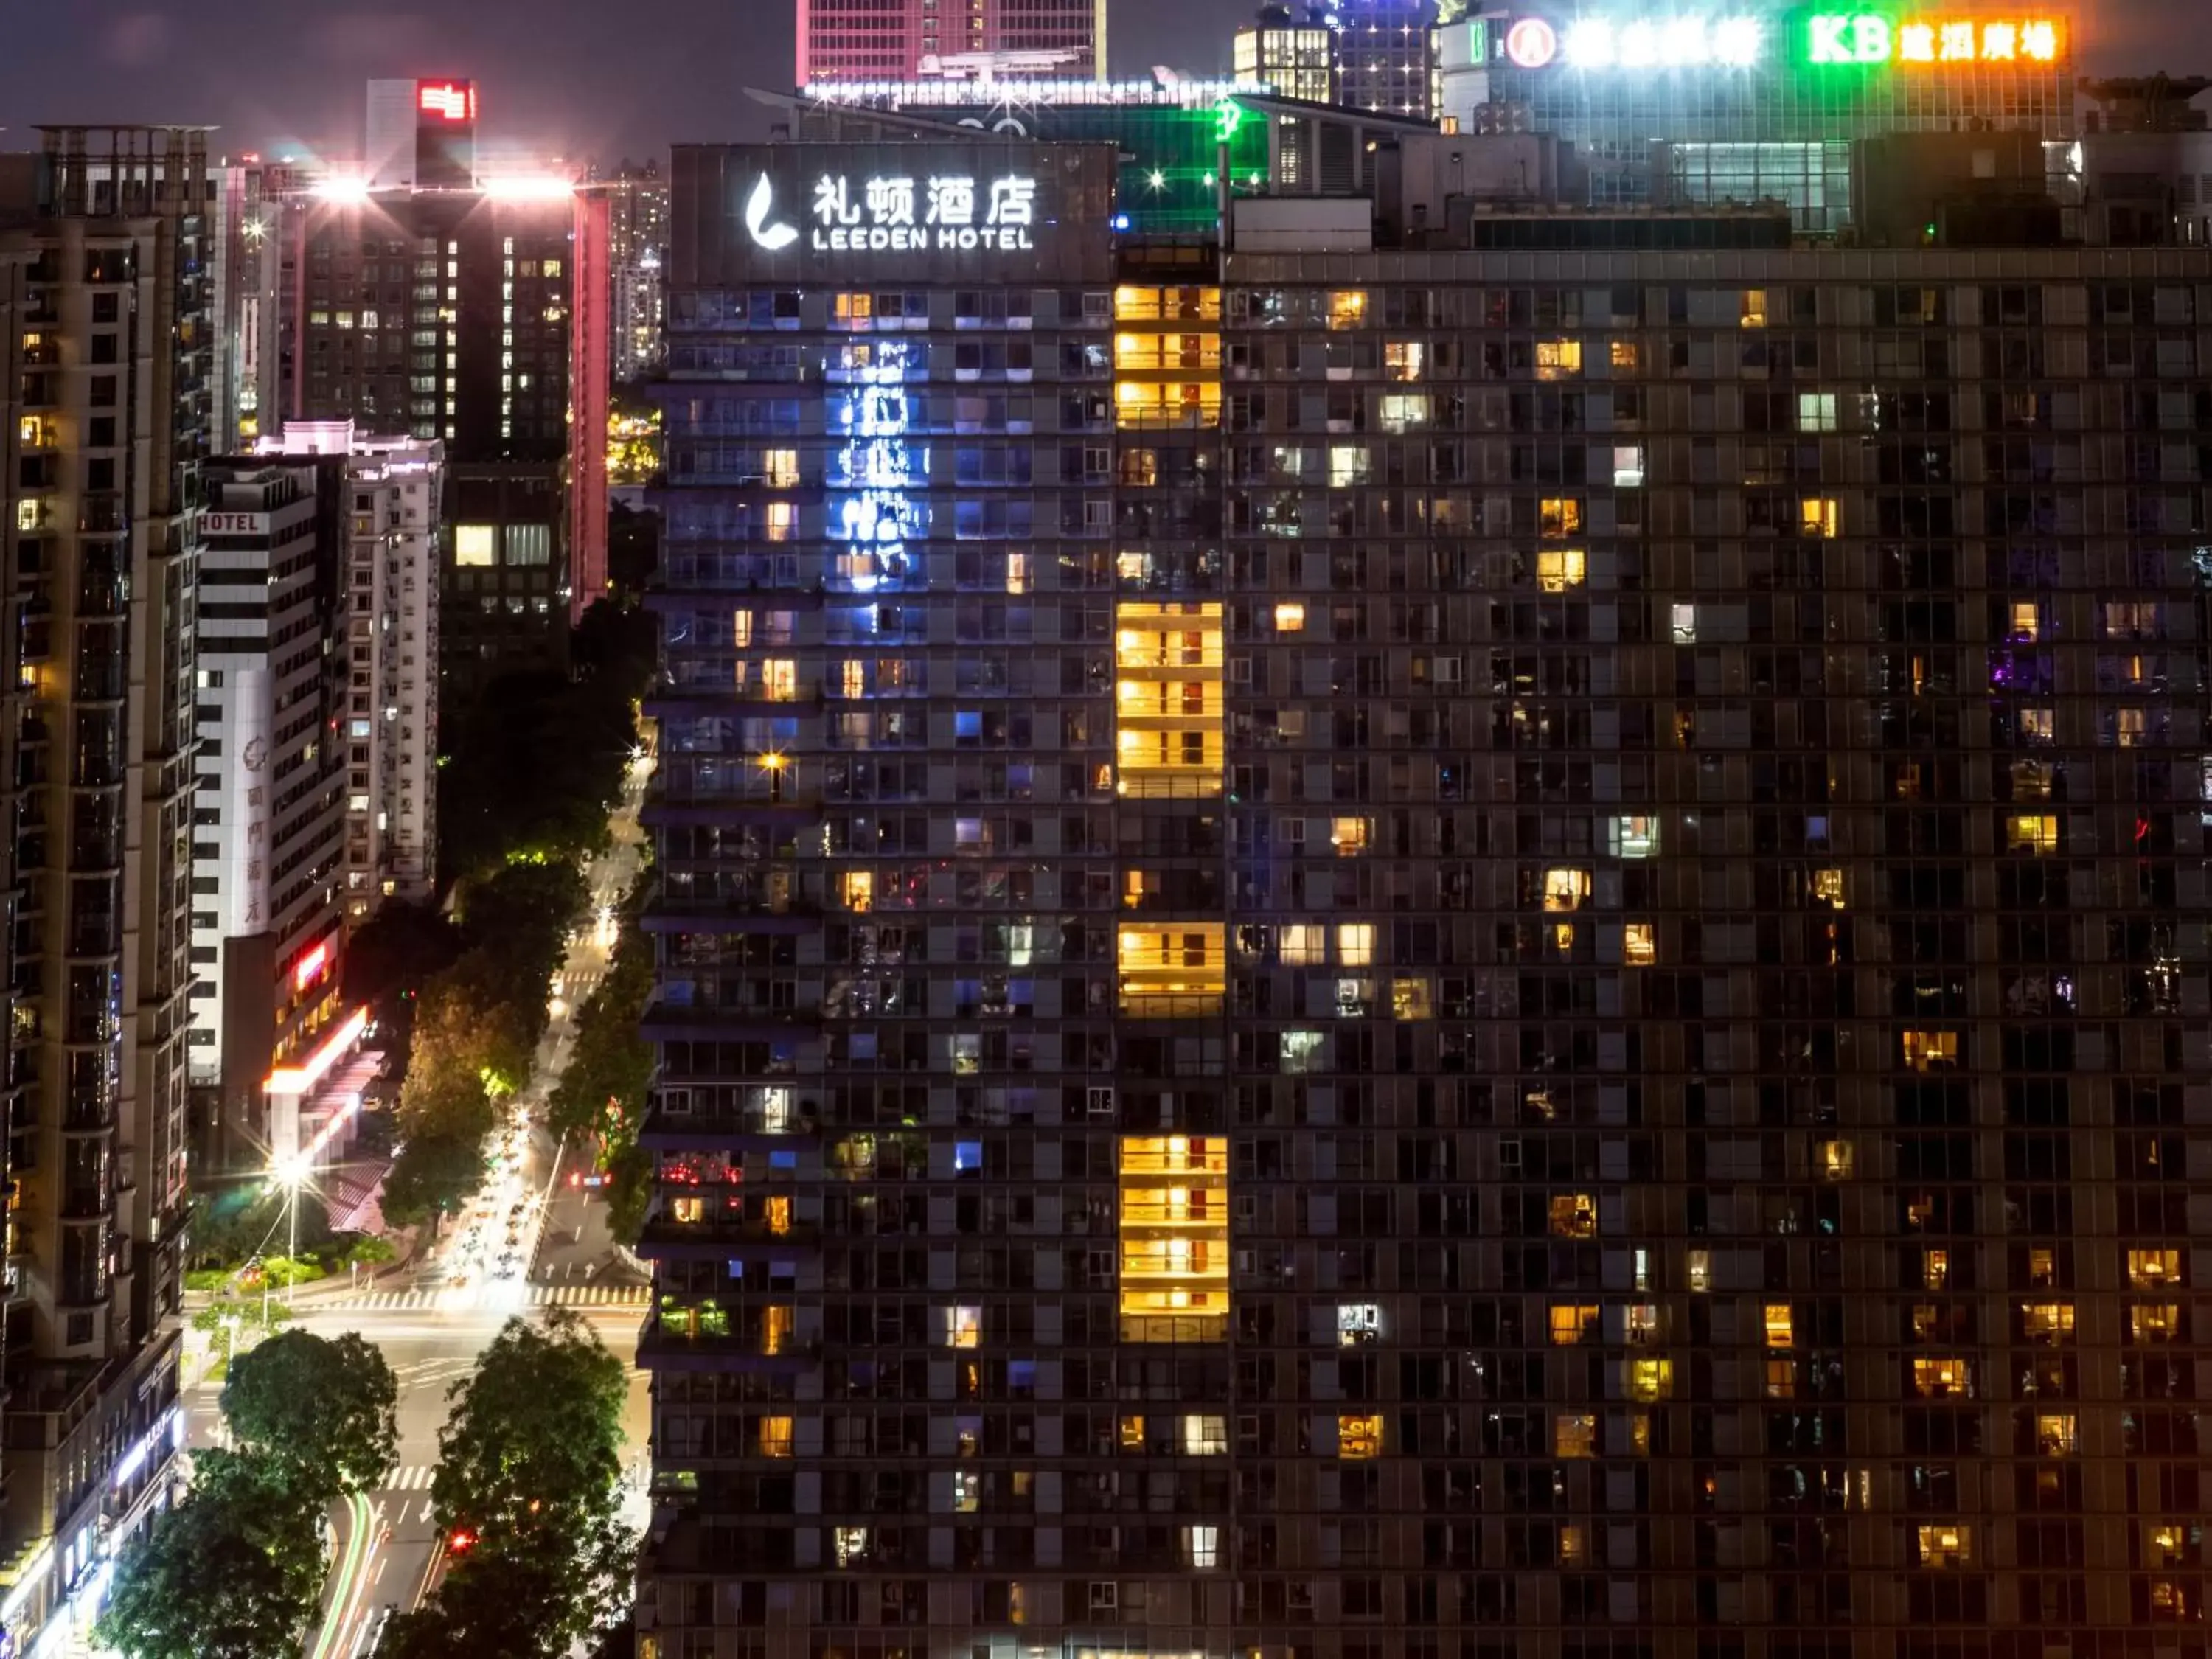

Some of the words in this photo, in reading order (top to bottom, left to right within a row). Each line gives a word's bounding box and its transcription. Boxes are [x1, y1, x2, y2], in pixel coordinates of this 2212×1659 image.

[1810, 15, 1891, 62] KB
[813, 173, 1036, 226] 礼顿酒店
[813, 229, 928, 250] LEEDEN
[939, 229, 1034, 250] HOTEL
[196, 514, 259, 531] HOTEL
